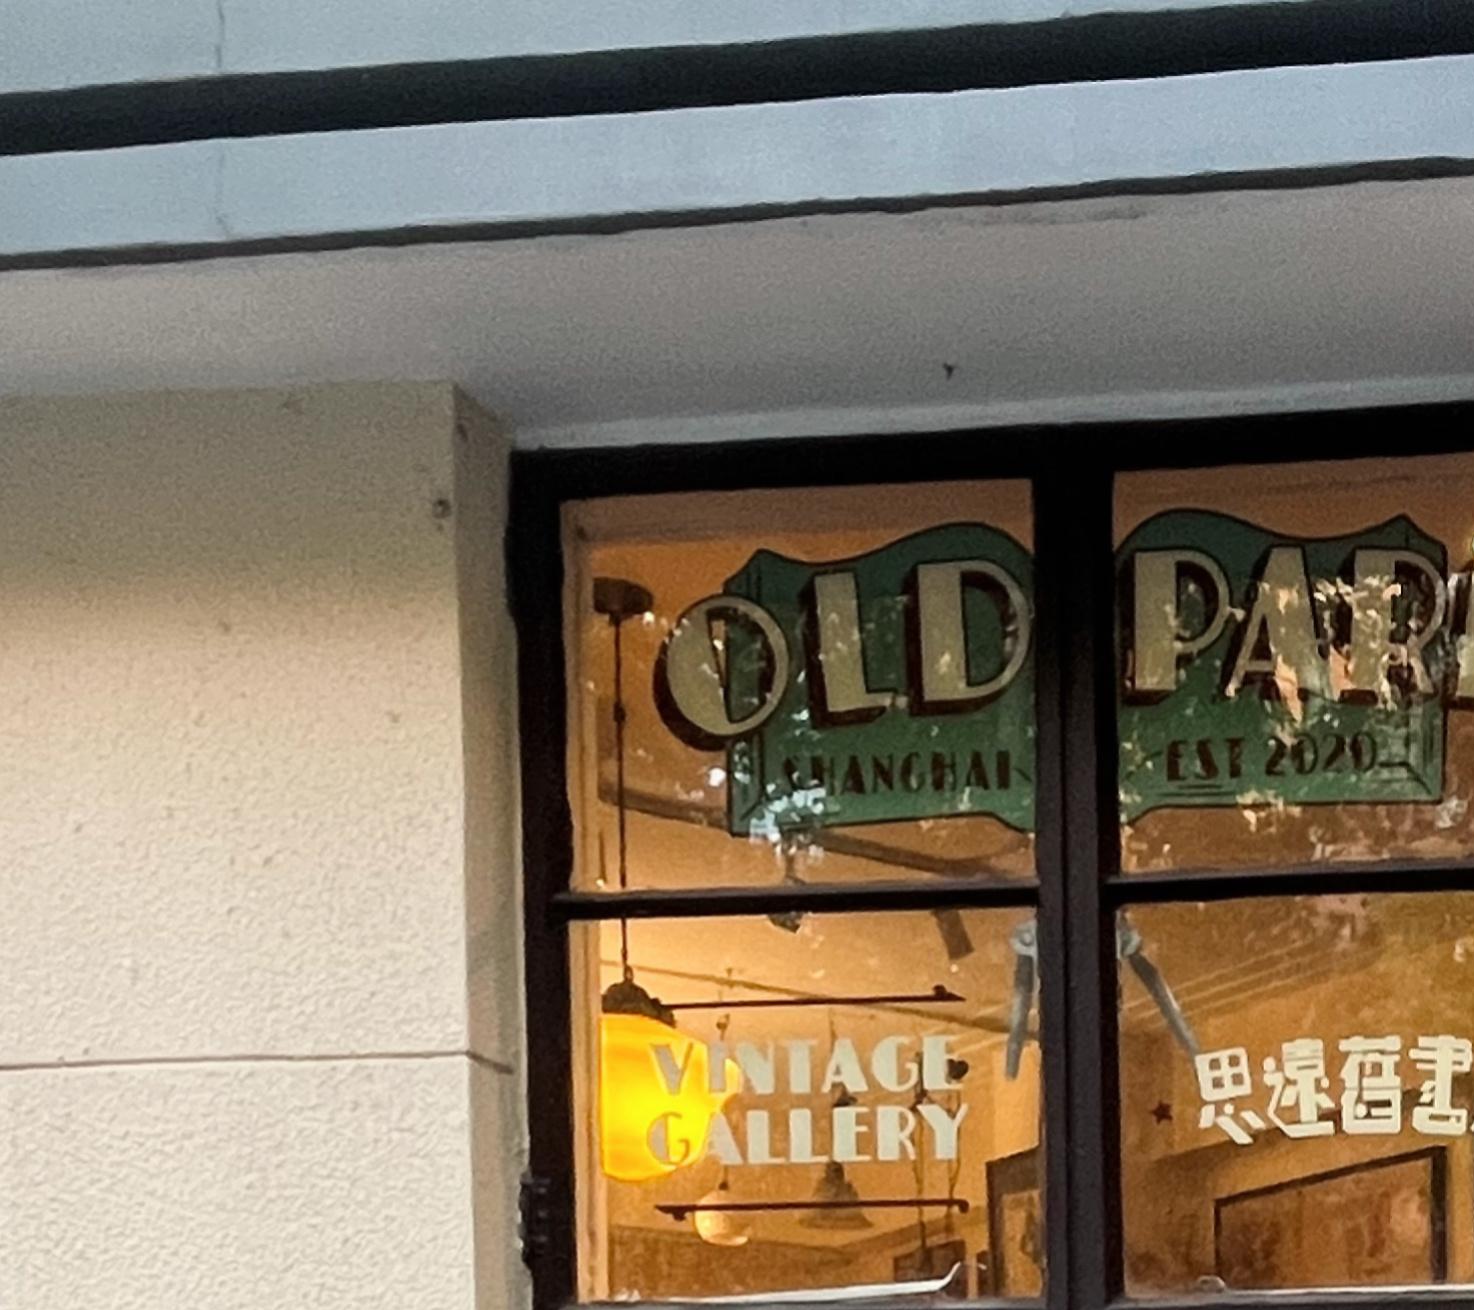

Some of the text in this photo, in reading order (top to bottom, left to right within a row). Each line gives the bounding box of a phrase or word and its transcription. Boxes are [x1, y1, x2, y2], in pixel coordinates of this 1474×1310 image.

[656, 557, 1034, 750] OLD
[782, 731, 1378, 797] SHANGHAI EST 2020
[648, 1034, 968, 1097] VINTAGE
[646, 1103, 970, 1170] GALLERY
